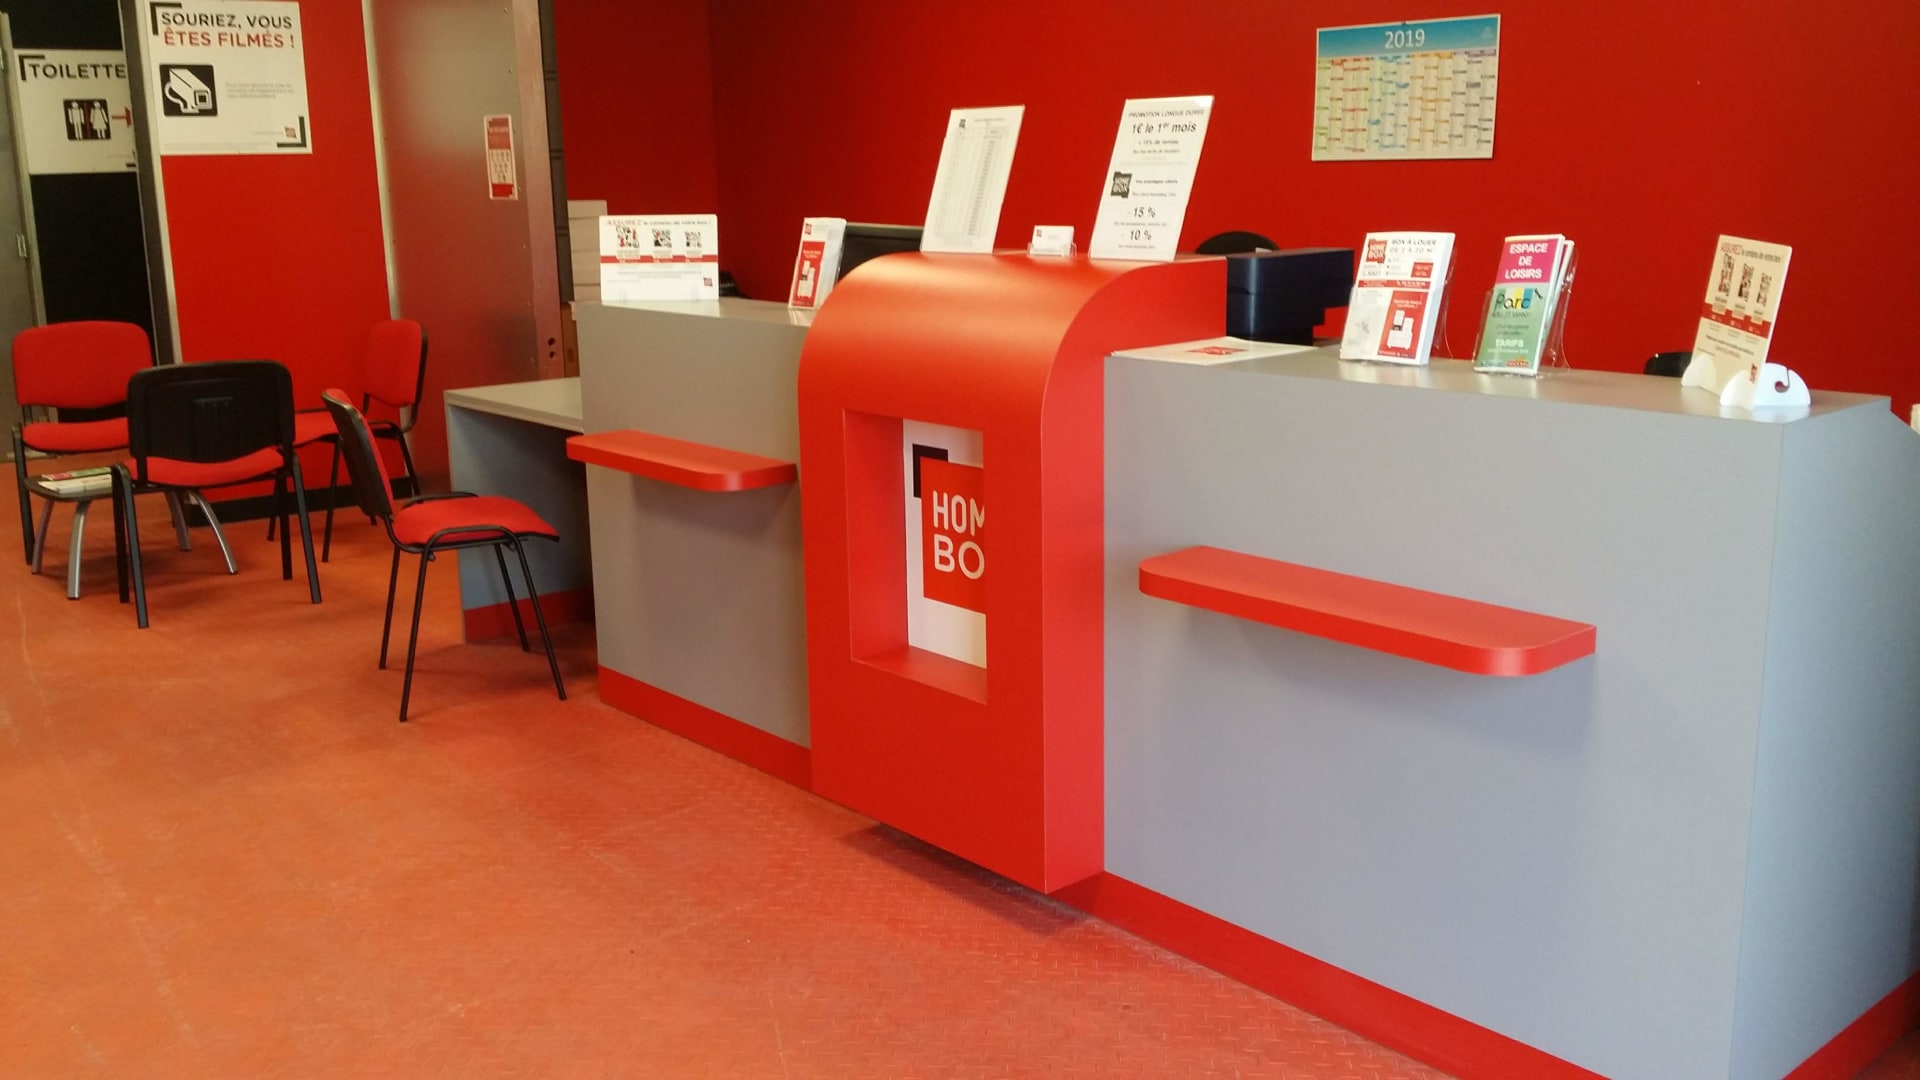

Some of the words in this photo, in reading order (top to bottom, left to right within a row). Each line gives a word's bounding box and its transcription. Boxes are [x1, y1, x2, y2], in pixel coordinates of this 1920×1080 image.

[161, 11, 242, 29] SOURIEZ,
[246, 15, 293, 29] VOUS
[164, 27, 211, 46] ÊTES
[218, 30, 285, 48] FILMÉS
[290, 34, 295, 49] !
[1384, 28, 1425, 49] 2019
[28, 63, 127, 79] TOILETTE
[1132, 122, 1143, 134] 1€
[1145, 123, 1154, 133] le
[1158, 122, 1169, 133] 1er
[1171, 121, 1197, 133] mois
[1134, 206, 1144, 218] 15
[1147, 206, 1156, 218] %
[1130, 229, 1141, 241] 10
[1144, 229, 1152, 241] %
[1509, 243, 1549, 254] ESPACE
[1518, 256, 1534, 266] DE
[1504, 268, 1543, 279] LOISIRS
[1495, 339, 1524, 348] TARIFS
[932, 490, 985, 536] HOM
[933, 533, 985, 580] BO
